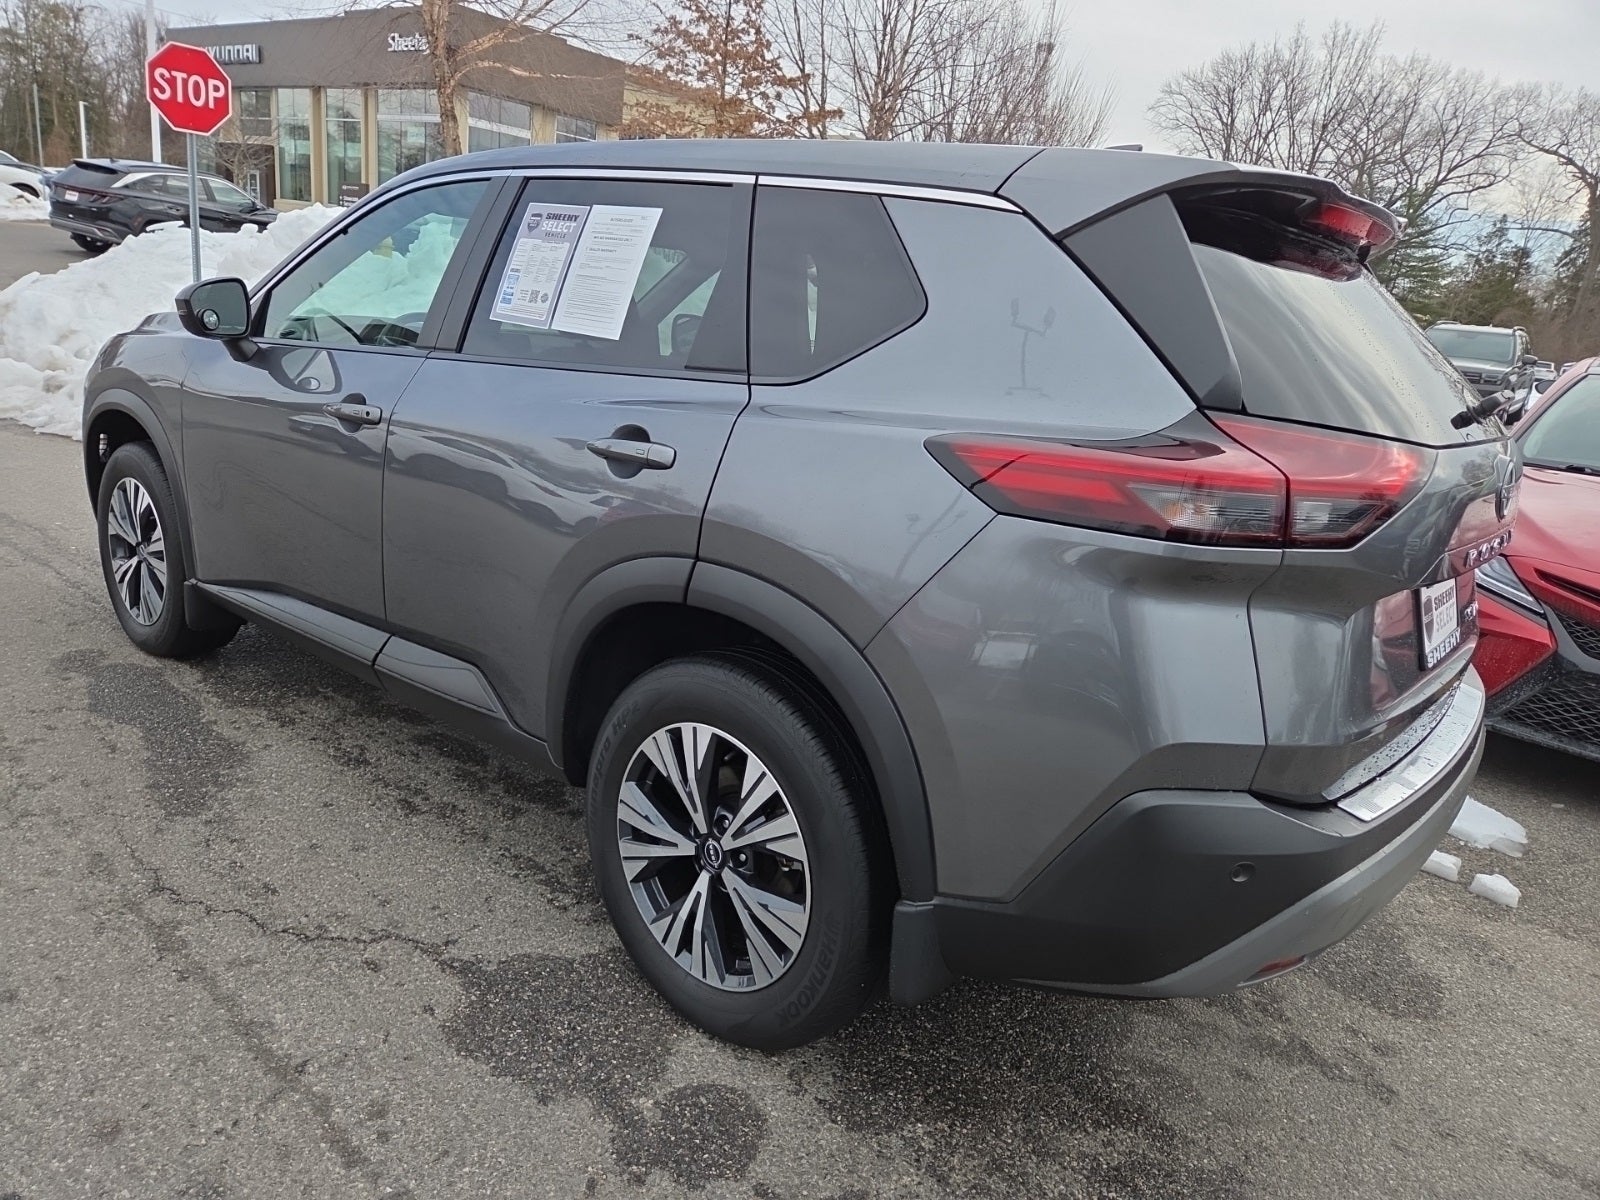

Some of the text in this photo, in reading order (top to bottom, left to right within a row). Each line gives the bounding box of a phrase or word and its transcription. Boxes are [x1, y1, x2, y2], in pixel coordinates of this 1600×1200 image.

[205, 43, 257, 62] YUNDAI
[153, 67, 225, 109] STOP
[541, 221, 576, 233] SELECT
[545, 212, 580, 222] SHEEHY
[1434, 587, 1455, 611] SHEEHY
[1435, 602, 1455, 632] SELECT
[1427, 628, 1461, 668] SHEEHY
